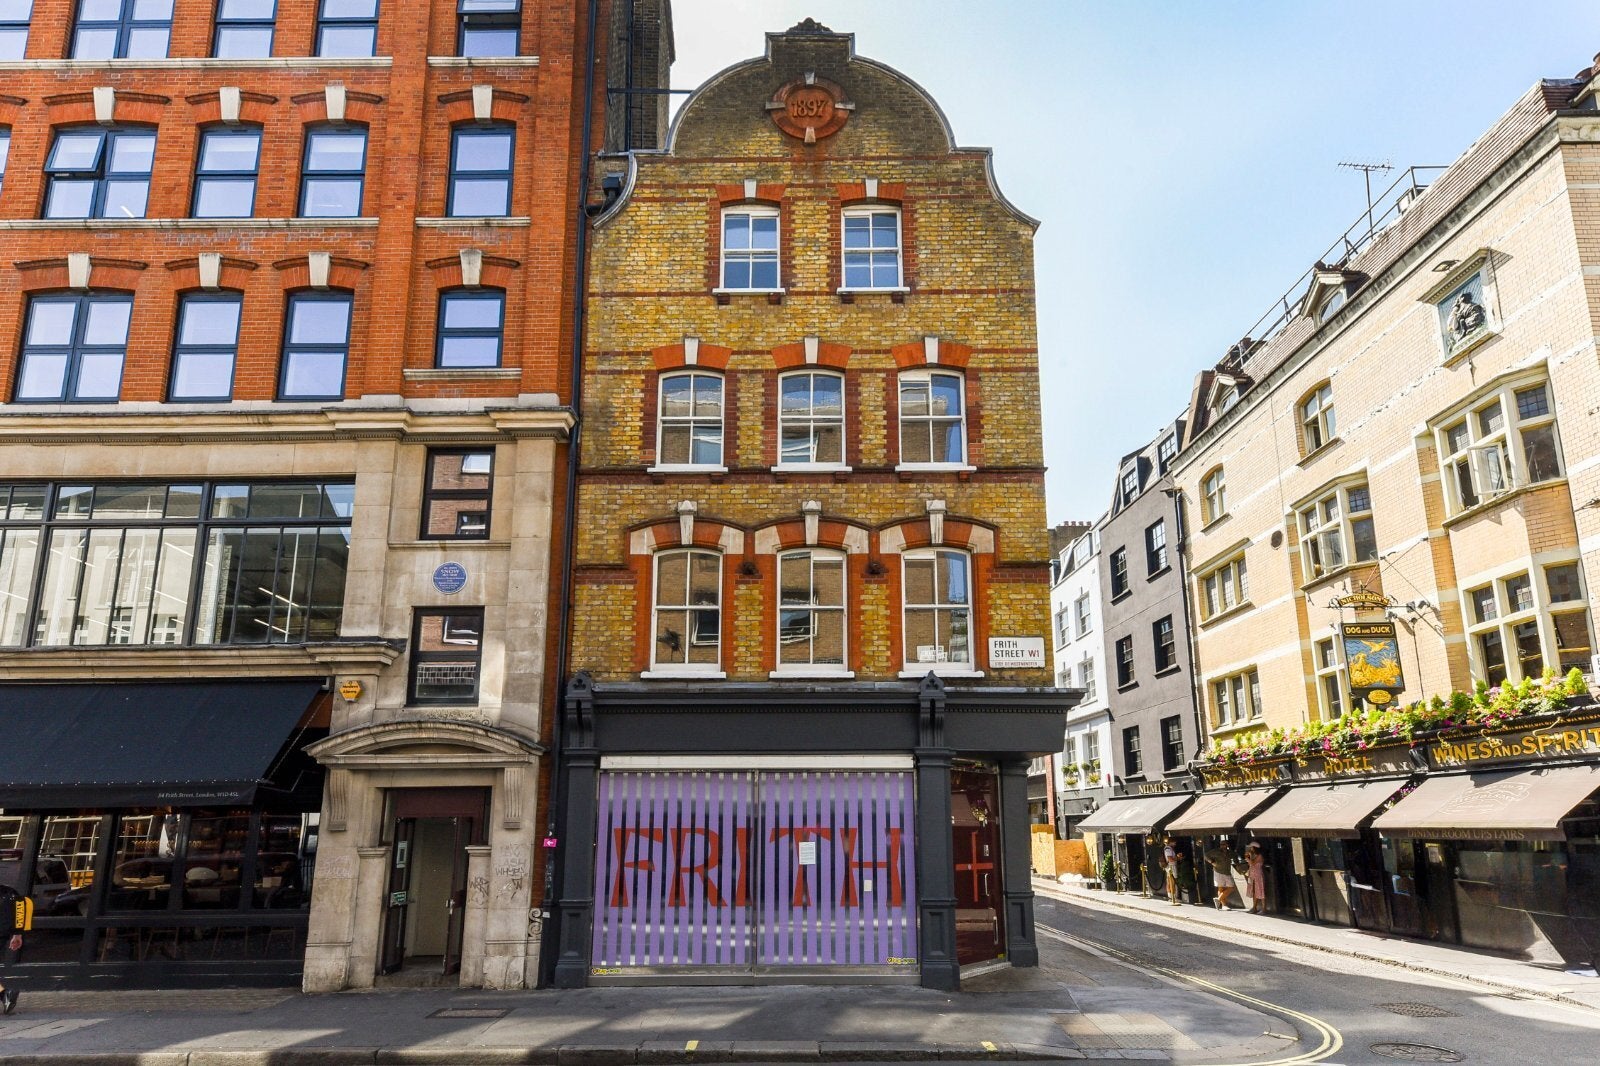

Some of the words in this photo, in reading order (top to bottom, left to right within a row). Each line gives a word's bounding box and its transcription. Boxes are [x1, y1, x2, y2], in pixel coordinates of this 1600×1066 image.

[792, 100, 827, 118] 1897
[1345, 626, 1361, 634] DOG
[1370, 626, 1391, 634] DUCK
[994, 640, 1018, 649] FRITH
[994, 649, 1025, 658] STREET
[1028, 649, 1040, 658] W1
[1432, 741, 1493, 764] WINES
[1493, 744, 1522, 758] AND
[1324, 755, 1374, 775] HOTEL
[1228, 776, 1243, 785] AND
[1244, 767, 1279, 784] DUCK
[1407, 829, 1440, 838] DINING
[1441, 830, 1471, 839] ROOM
[1472, 830, 1525, 840] UPSTAIRS
[610, 827, 904, 908] FRITH
